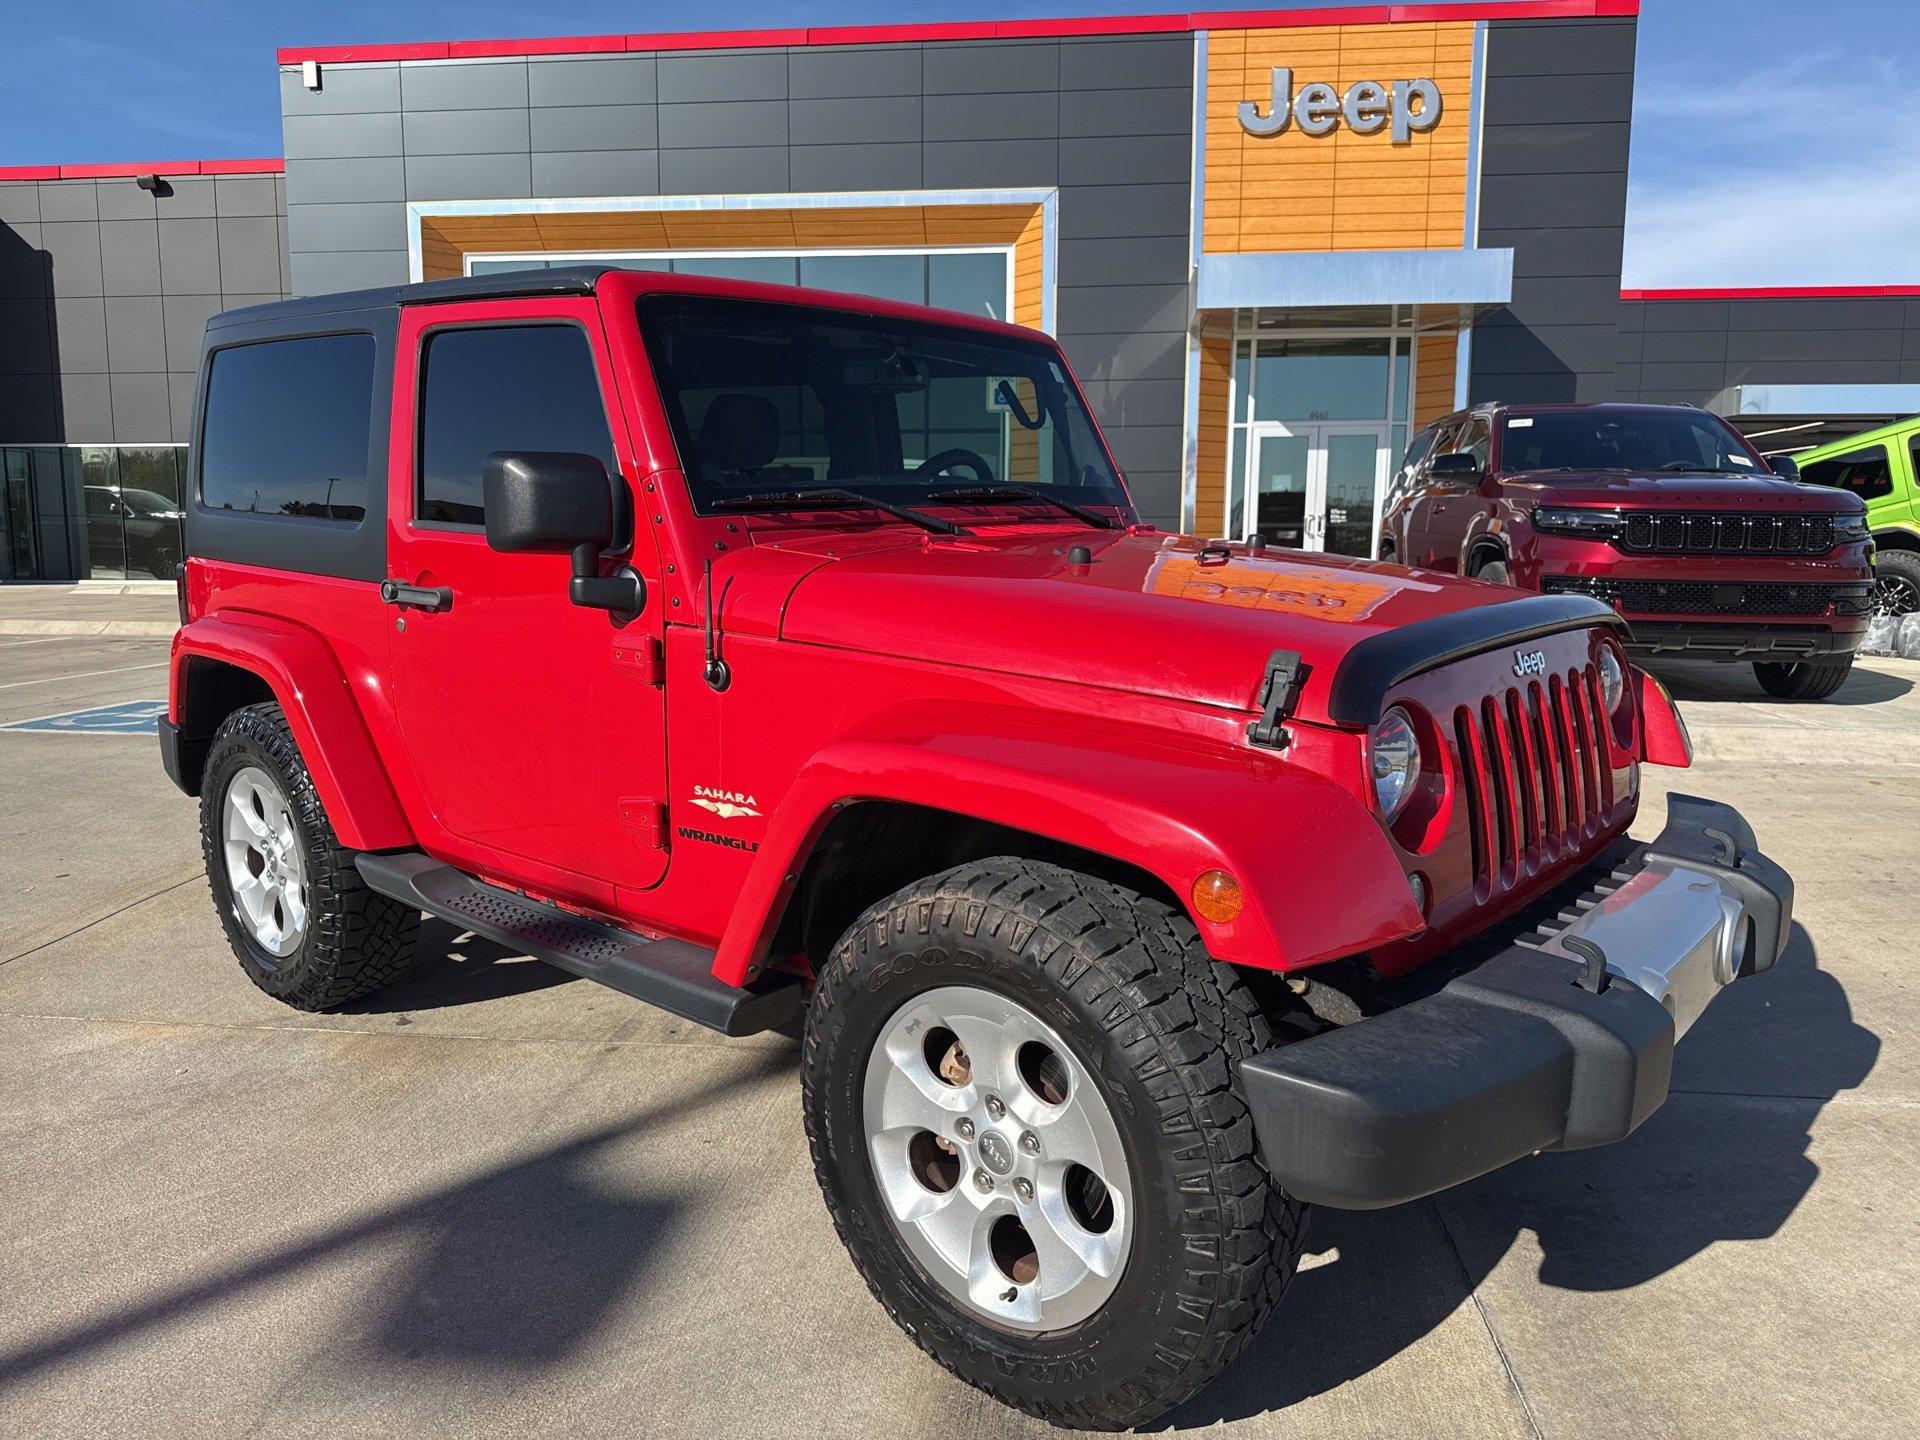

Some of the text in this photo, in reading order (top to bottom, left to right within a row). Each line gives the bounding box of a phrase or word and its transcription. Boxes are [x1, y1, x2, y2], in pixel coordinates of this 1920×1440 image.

[1238, 66, 1442, 145] Jeep
[1512, 650, 1545, 676] Jeep
[694, 785, 757, 806] SAHARA
[678, 827, 759, 852] WRANGLE
